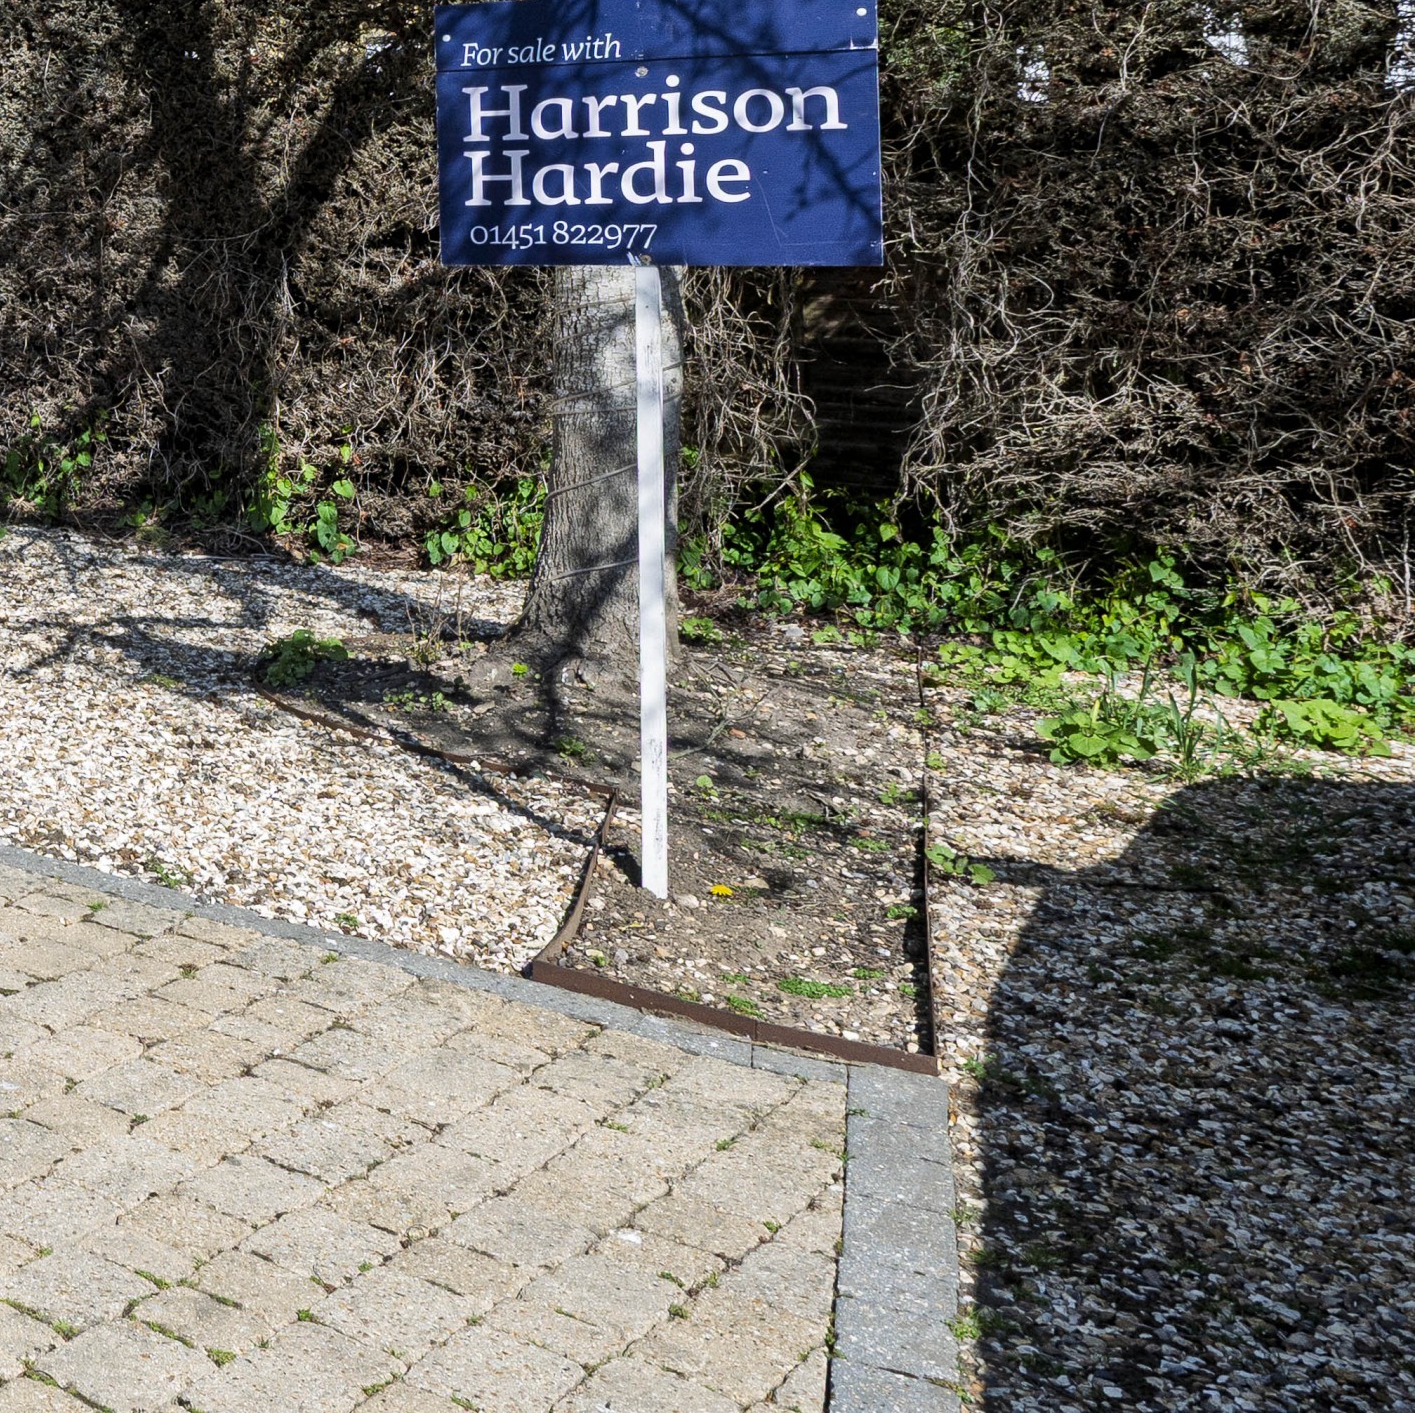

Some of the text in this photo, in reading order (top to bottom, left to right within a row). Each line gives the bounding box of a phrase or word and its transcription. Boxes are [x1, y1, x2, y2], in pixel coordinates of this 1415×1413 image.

[460, 33, 622, 67] For sale with
[461, 74, 848, 142] Harrison
[463, 140, 752, 207] Hardie
[470, 220, 658, 250] 01451 822977
